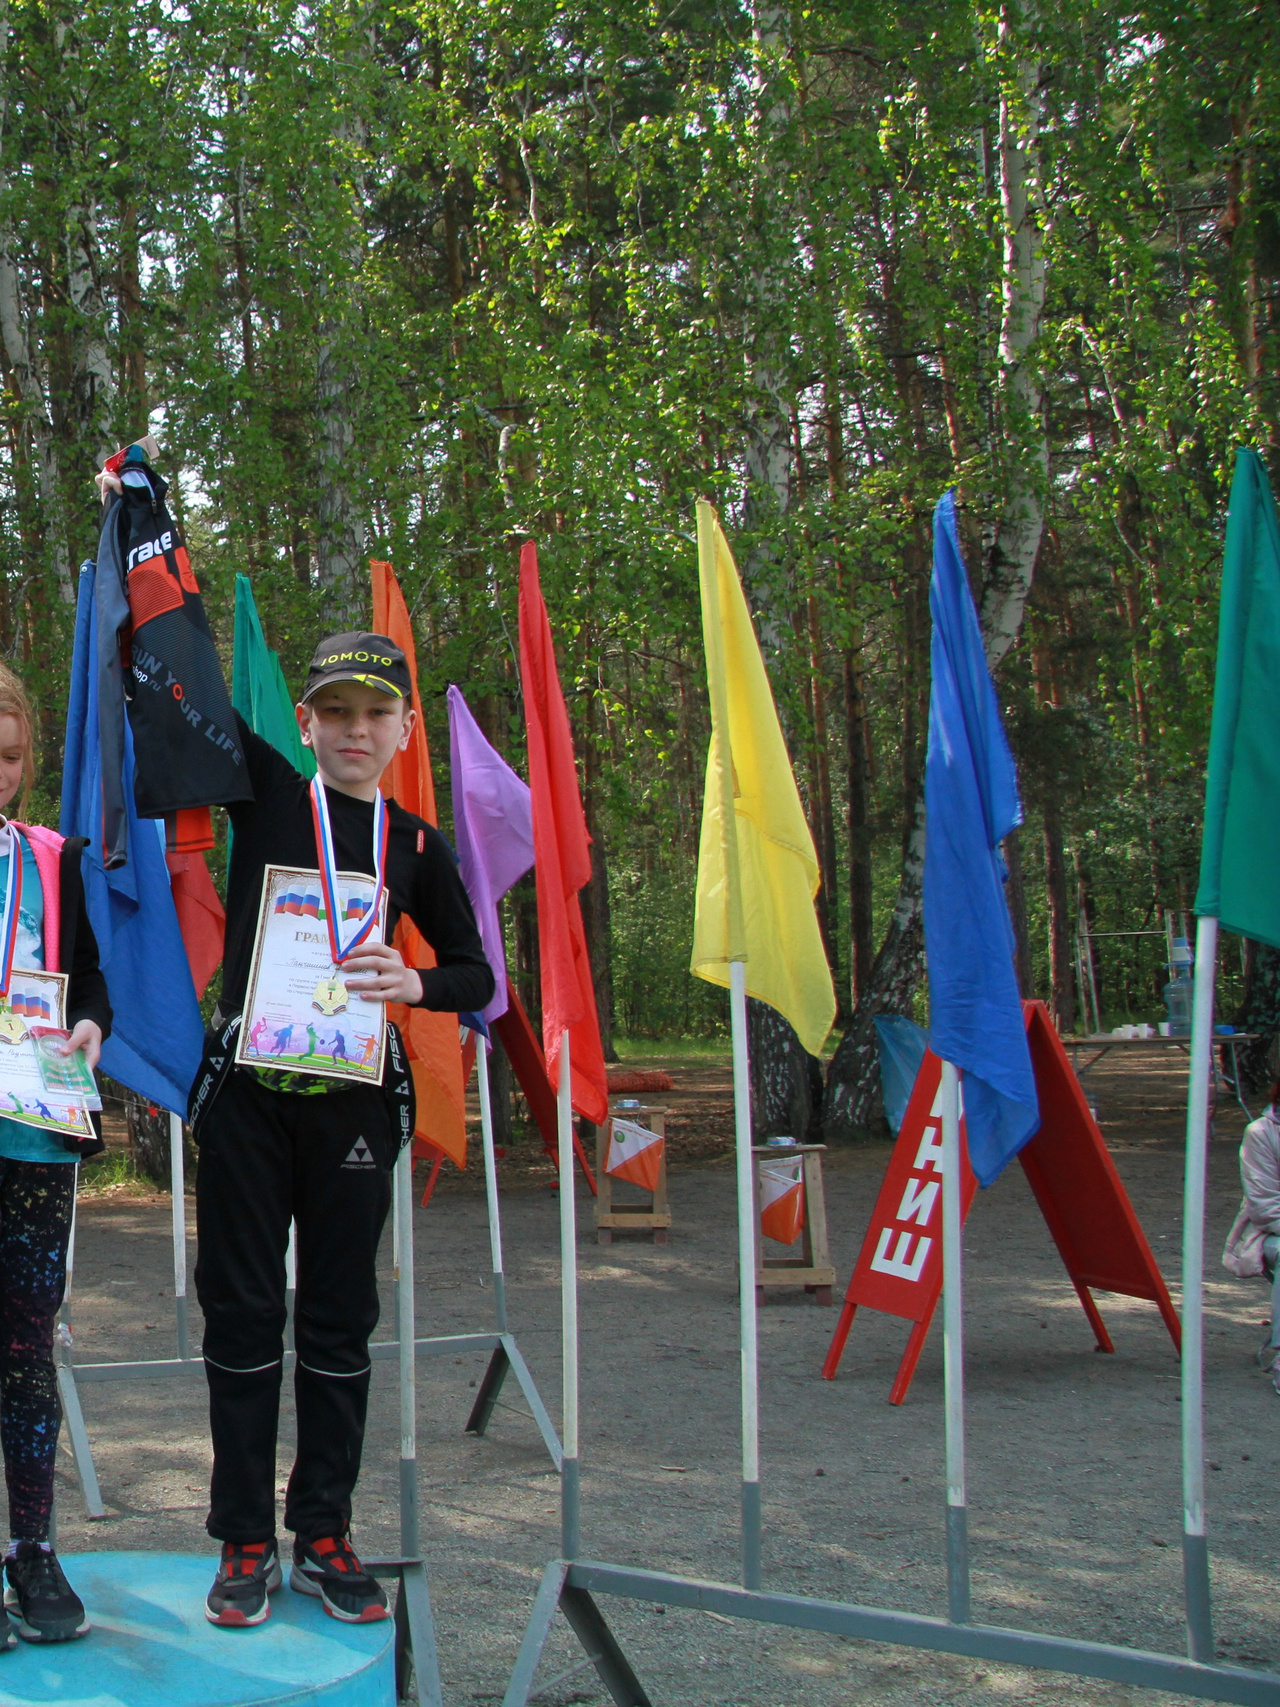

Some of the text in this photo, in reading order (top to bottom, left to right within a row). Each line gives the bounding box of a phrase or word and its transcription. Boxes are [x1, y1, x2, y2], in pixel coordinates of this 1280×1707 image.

[127, 531, 172, 574] race
[165, 670, 202, 728] YOUR
[204, 723, 241, 766] LIFE
[327, 991, 333, 1000] 1
[8, 1022, 14, 1031] 1
